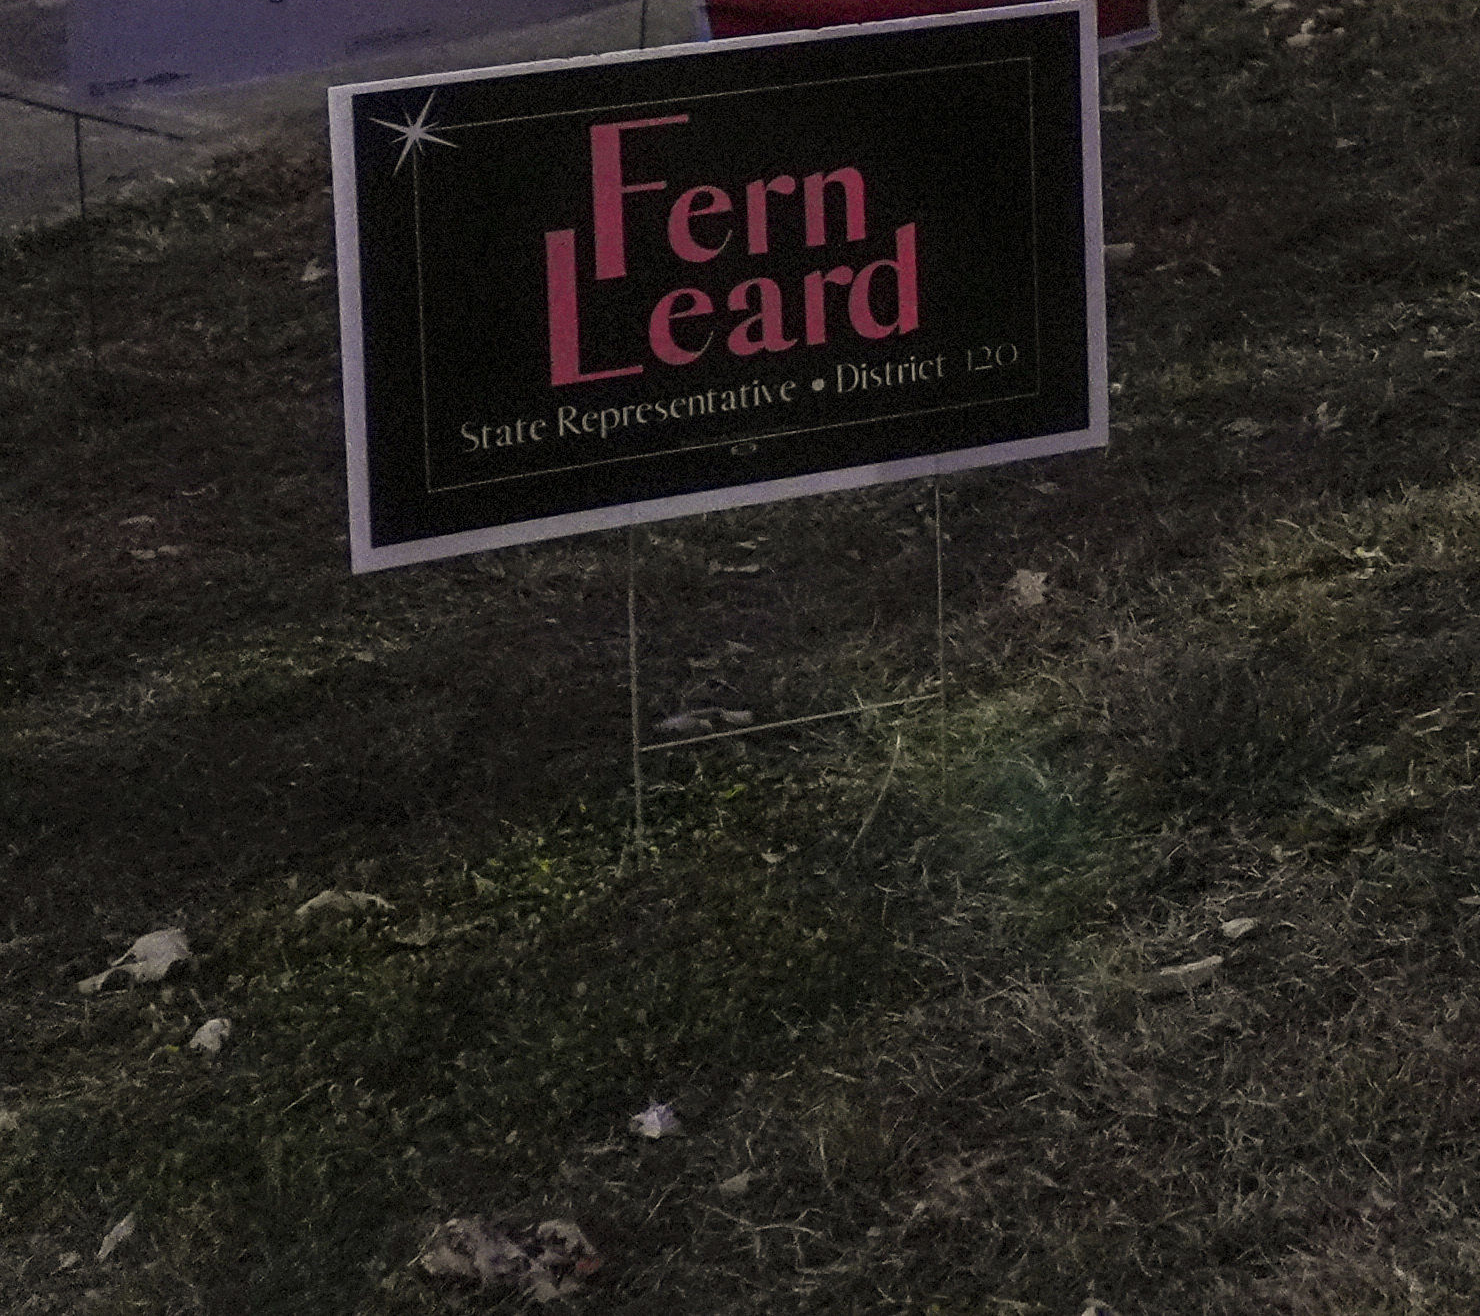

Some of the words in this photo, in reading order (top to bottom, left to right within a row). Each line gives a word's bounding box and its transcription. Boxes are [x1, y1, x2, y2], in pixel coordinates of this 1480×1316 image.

[589, 114, 867, 281] Fern
[544, 222, 921, 388] Leard
[460, 412, 547, 456] State
[556, 377, 798, 444] Representative
[836, 350, 949, 395] District
[963, 342, 1020, 373] 120
